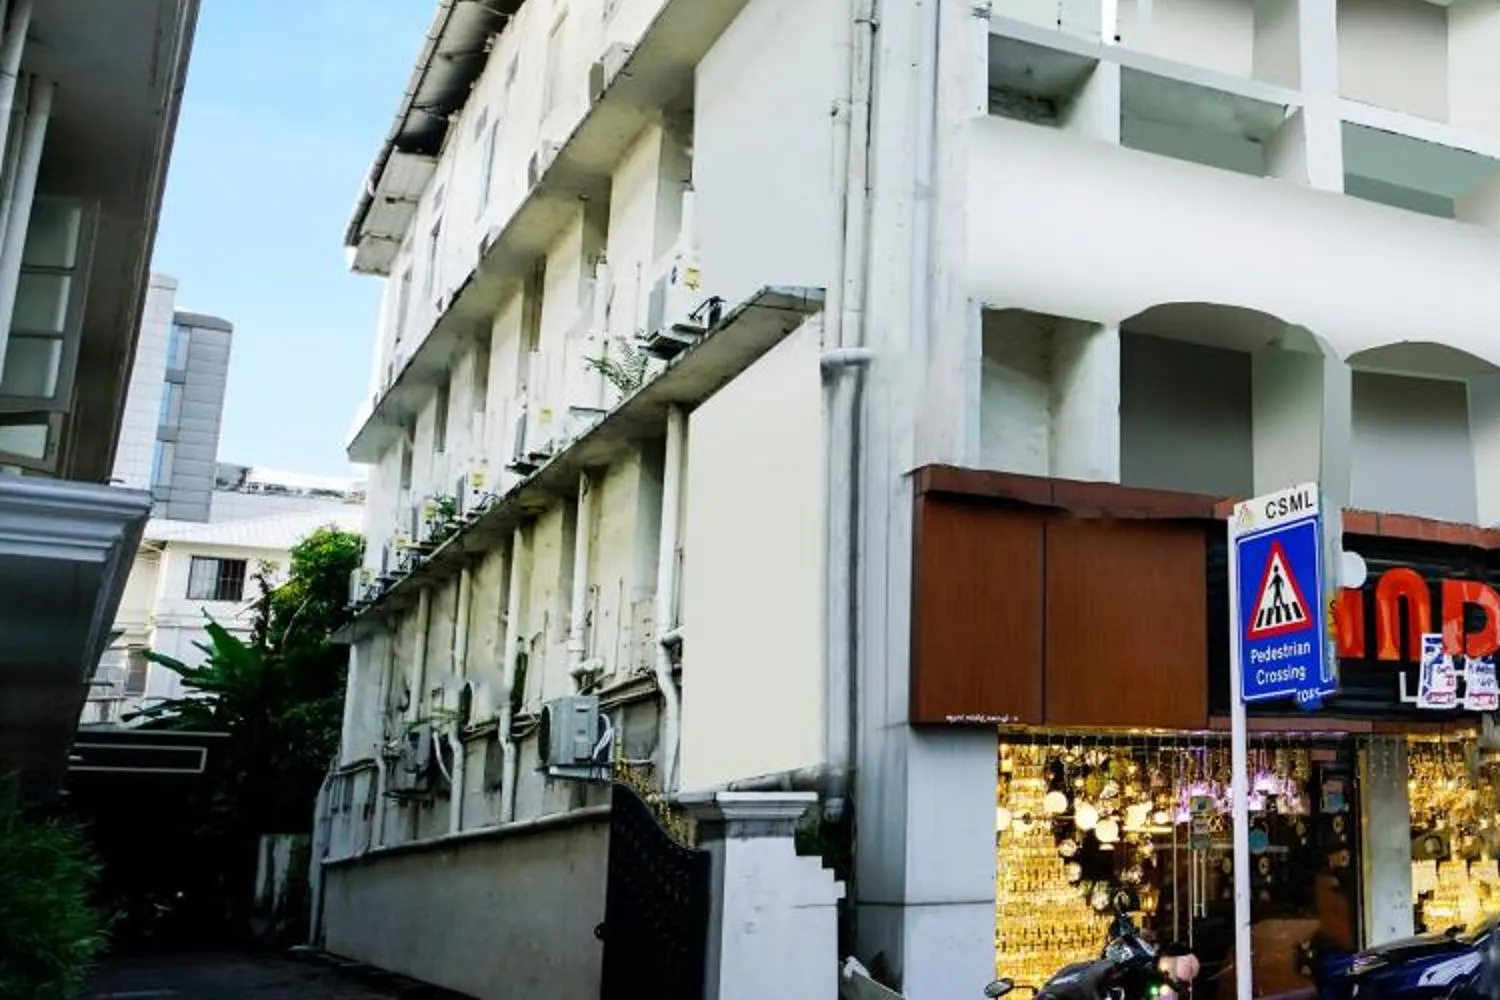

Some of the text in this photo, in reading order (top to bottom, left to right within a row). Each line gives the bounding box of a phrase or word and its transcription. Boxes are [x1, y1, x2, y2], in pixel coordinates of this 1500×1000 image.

[1265, 490, 1313, 519] CSML
[1250, 641, 1311, 664] Pedestrian
[1256, 665, 1306, 685] Crossing
